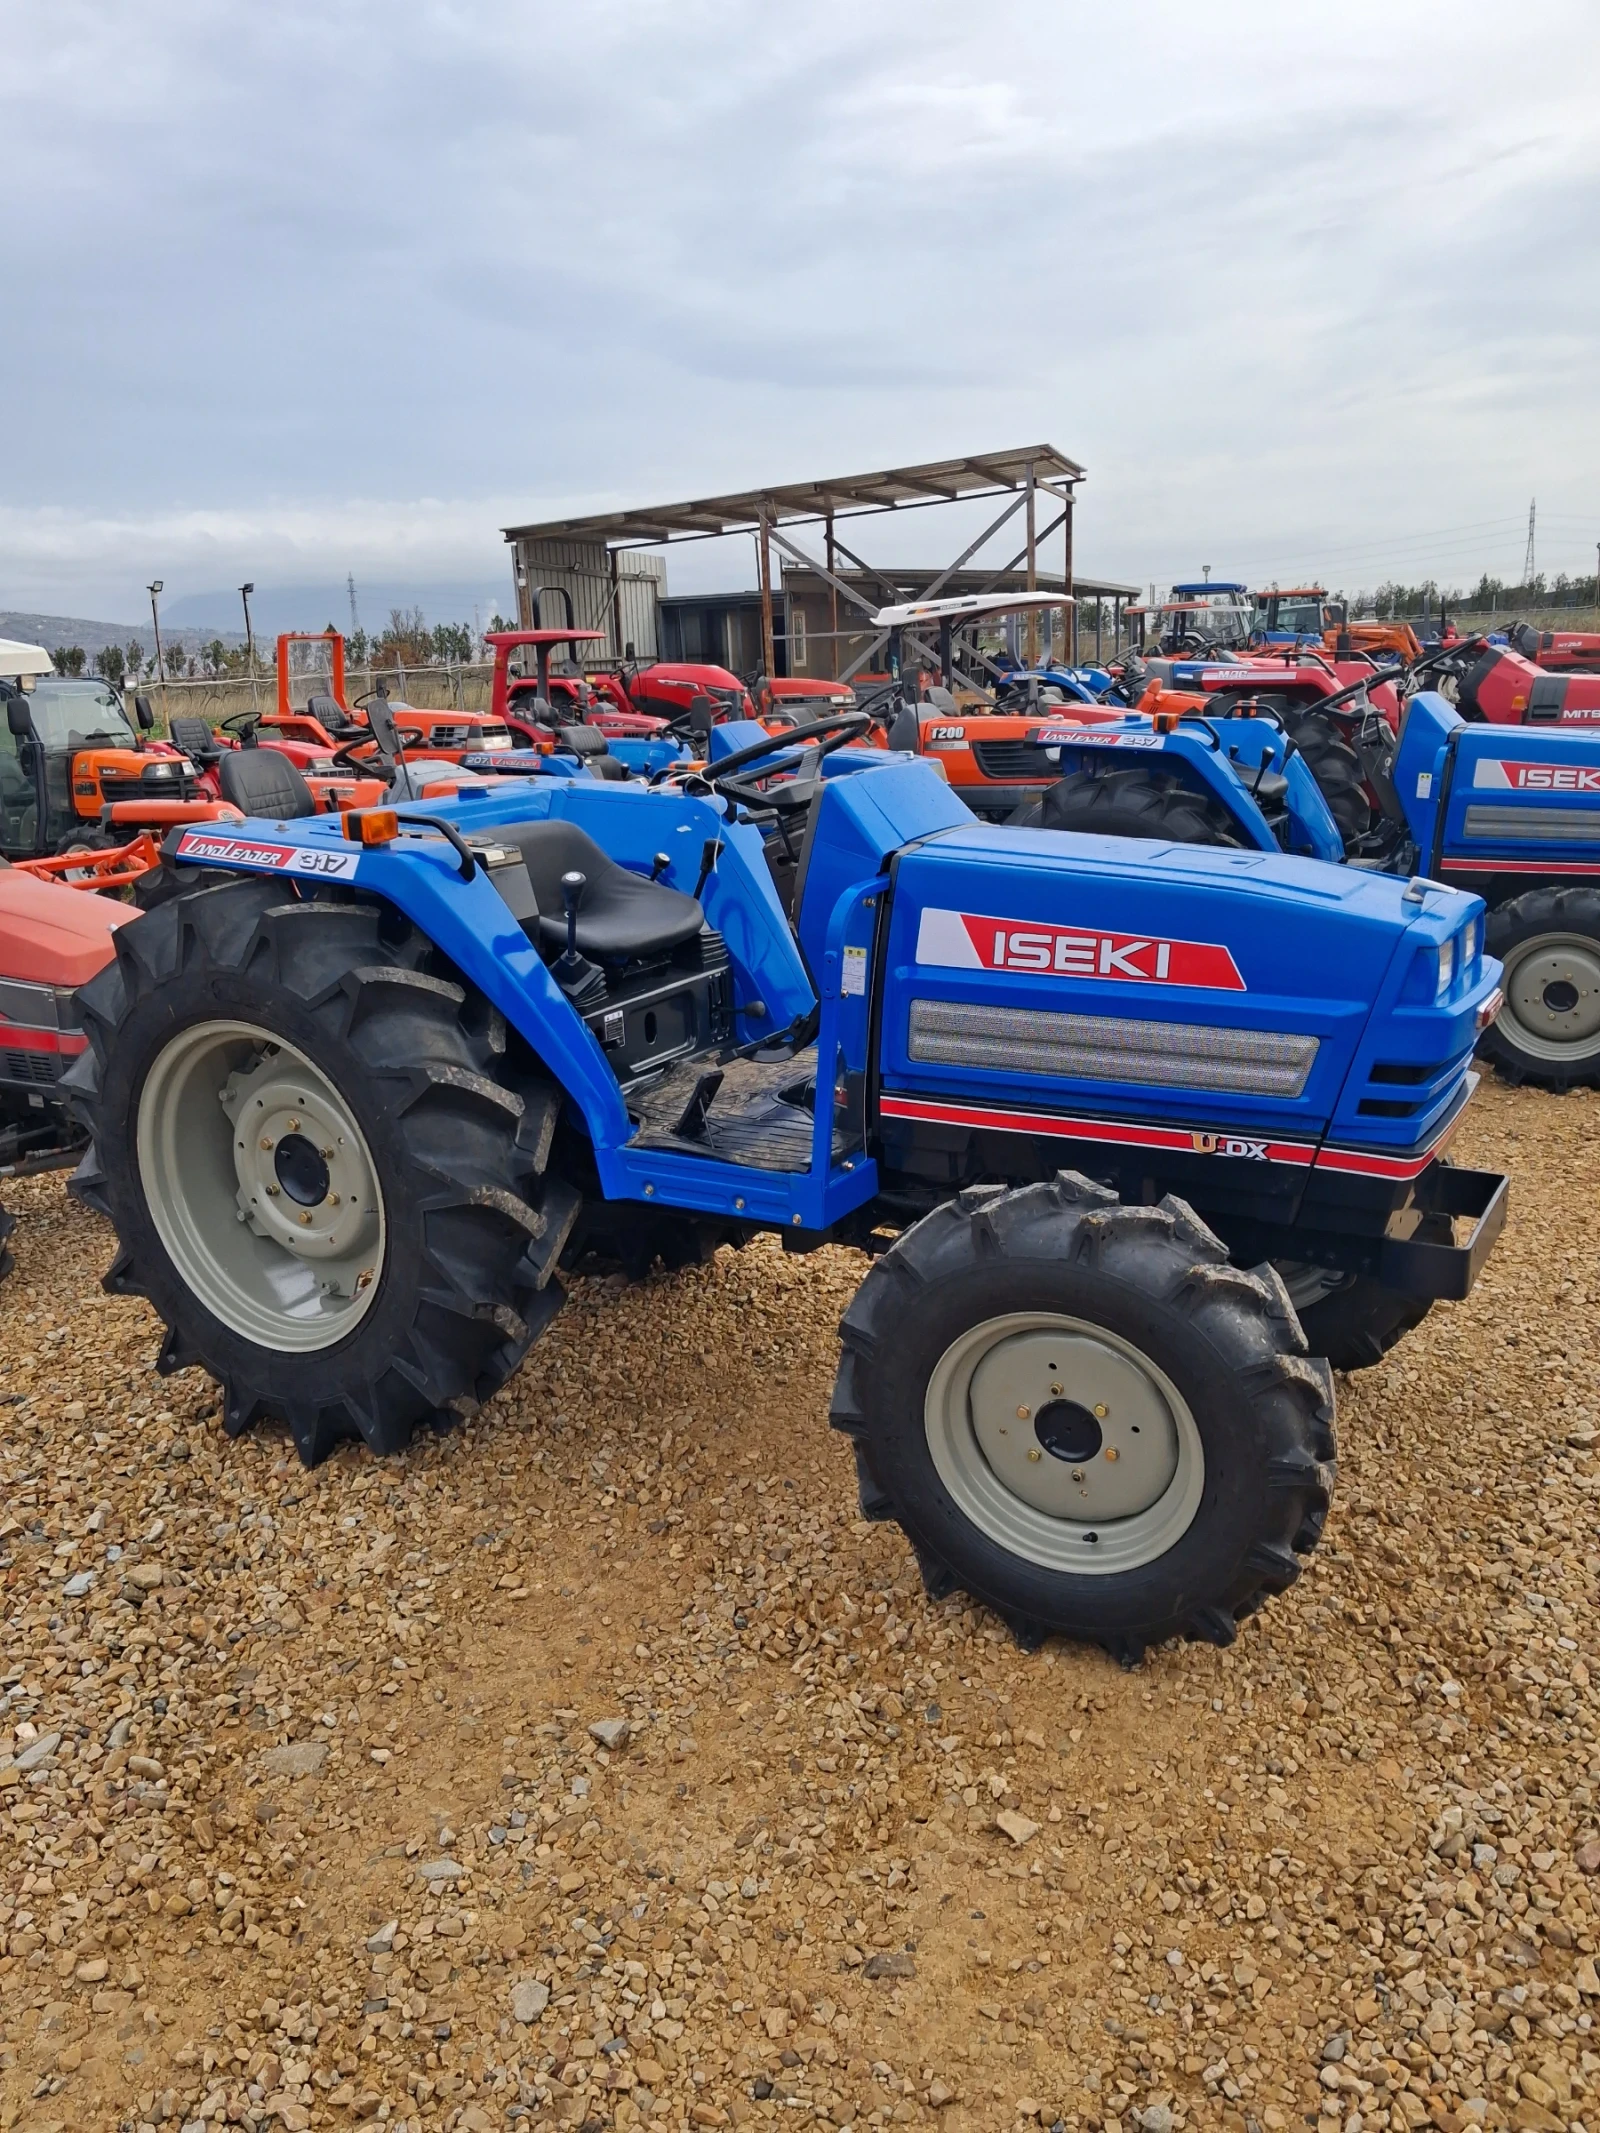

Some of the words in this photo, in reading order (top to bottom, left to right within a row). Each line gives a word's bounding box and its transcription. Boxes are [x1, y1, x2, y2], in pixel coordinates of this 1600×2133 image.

[931, 727, 965, 739] T200
[1122, 736, 1157, 746] 247
[299, 851, 347, 873] 317
[993, 931, 1170, 979] ISEKI
